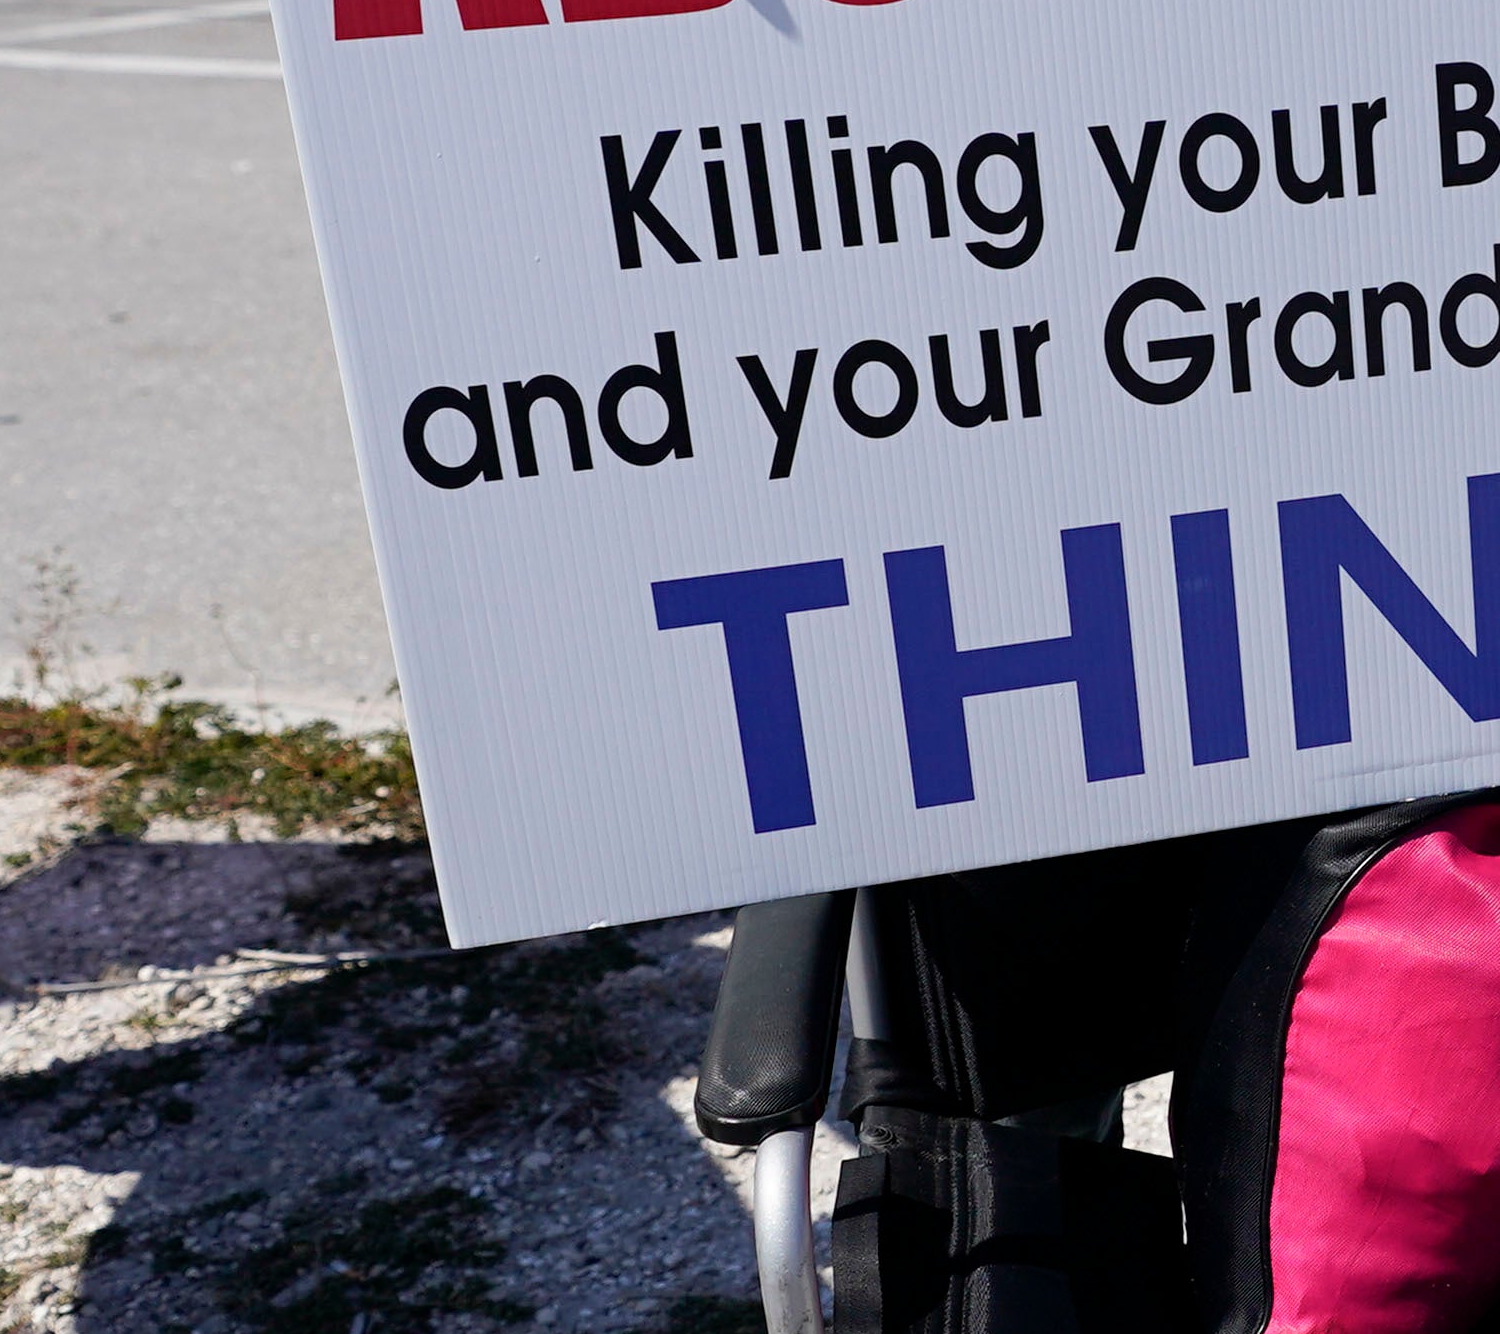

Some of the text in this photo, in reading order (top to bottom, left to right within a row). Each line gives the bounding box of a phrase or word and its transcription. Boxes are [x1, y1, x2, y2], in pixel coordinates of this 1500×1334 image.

[599, 115, 1044, 271] Killing
[1087, 97, 1388, 254] your
[402, 330, 695, 490] and
[734, 319, 1051, 481] your
